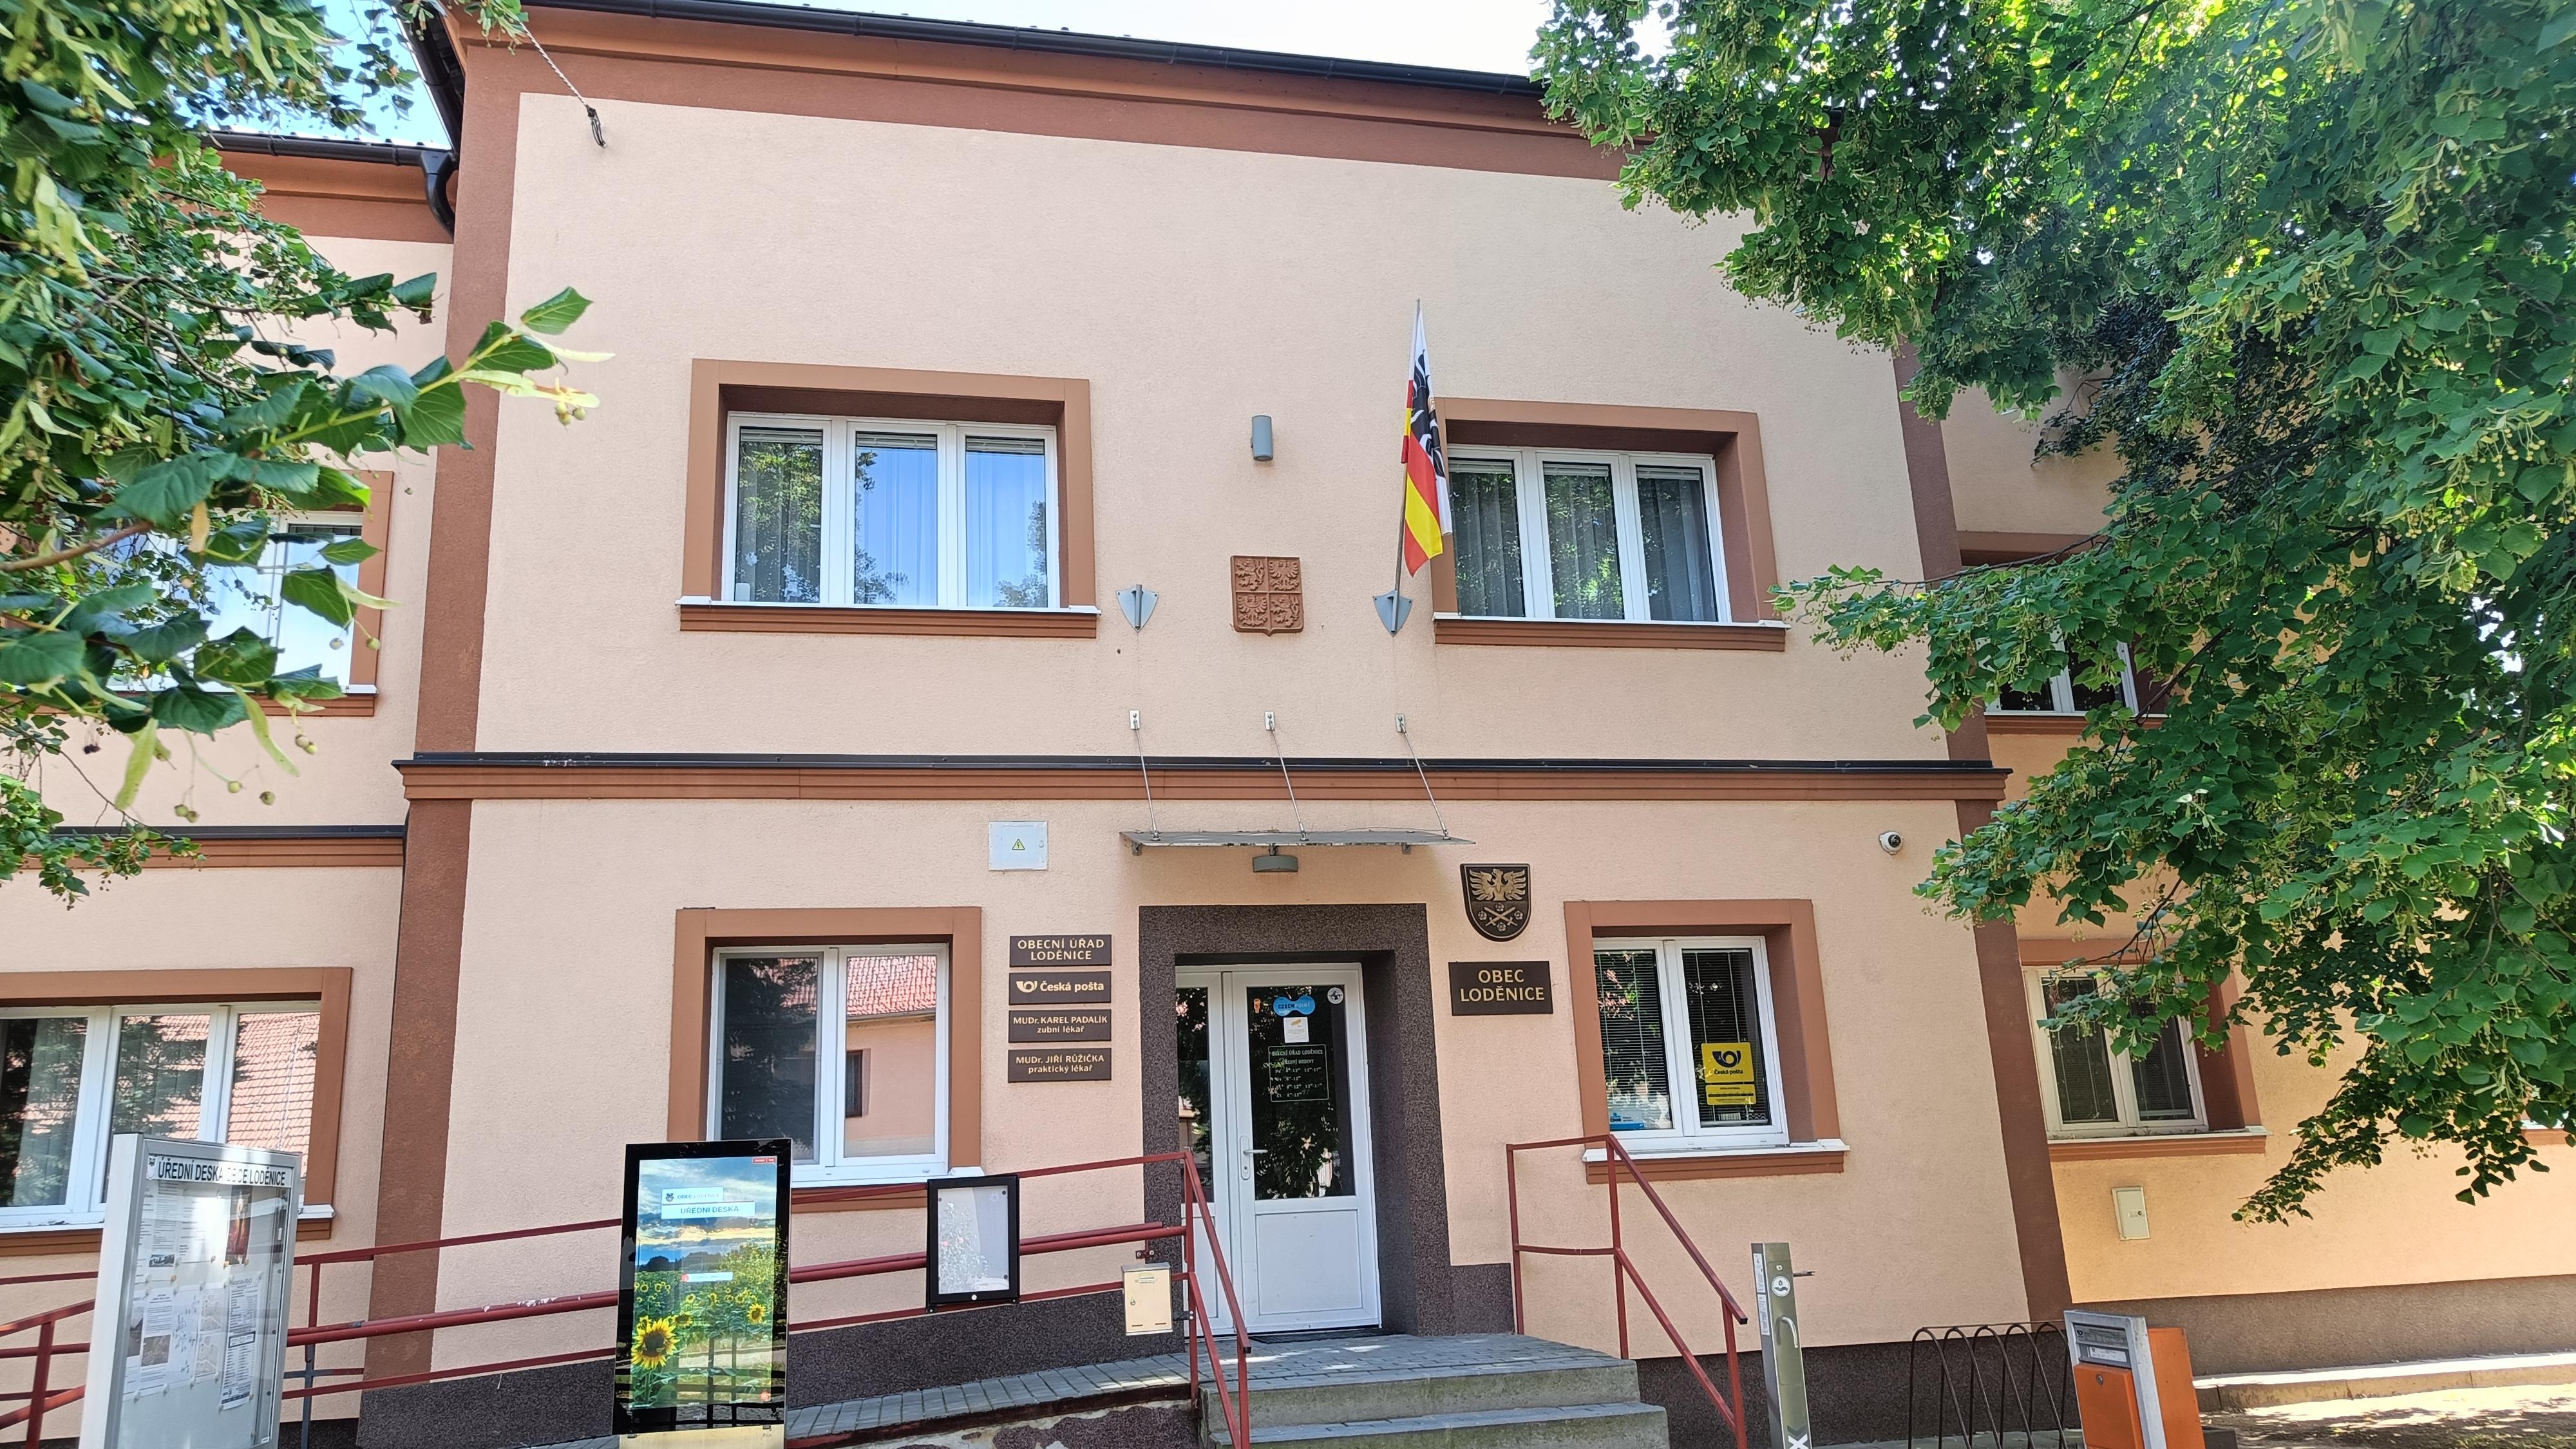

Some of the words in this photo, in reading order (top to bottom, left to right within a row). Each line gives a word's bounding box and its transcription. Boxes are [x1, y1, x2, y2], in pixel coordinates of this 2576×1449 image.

[1018, 938, 1065, 949] OBECNÍ
[1070, 938, 1104, 949] ÚŘAD
[1031, 949, 1092, 960] LODĚNICE
[1478, 969, 1524, 983] OBEC
[1040, 981, 1072, 992] Česká
[1074, 981, 1104, 992] pošta
[1460, 985, 1545, 1002] LODĚNICE
[1071, 1015, 1108, 1024] PADALÍK
[1045, 1054, 1063, 1063] JIŘÍ
[1065, 1054, 1104, 1063] RŮŽIČKA
[1028, 1065, 1069, 1074] praktický
[158, 1157, 194, 1179] ÚŘEDNÍ
[195, 1164, 223, 1182] DESKA
[249, 1167, 286, 1186] LODĚNICE
